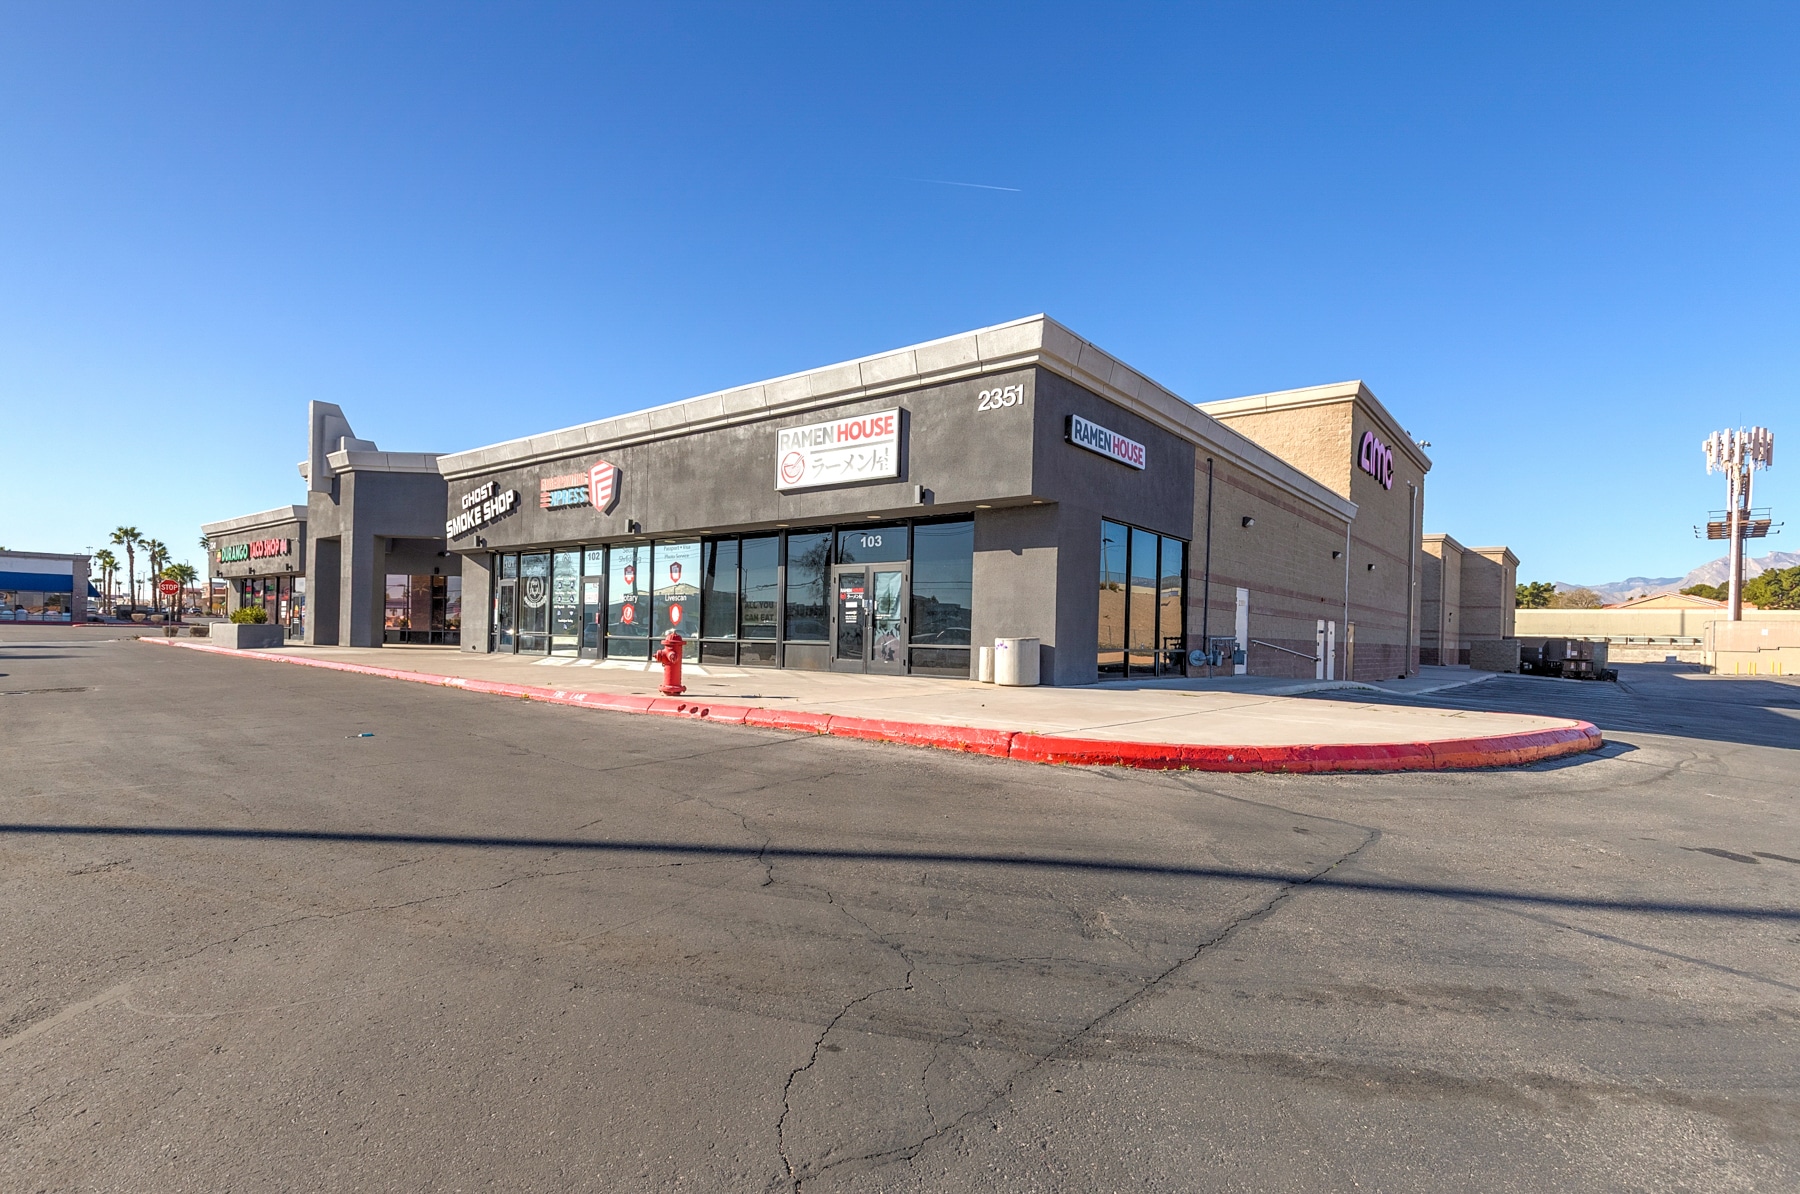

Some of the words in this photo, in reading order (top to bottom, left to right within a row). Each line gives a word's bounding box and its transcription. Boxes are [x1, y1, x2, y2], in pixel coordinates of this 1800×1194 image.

[978, 384, 1024, 411] 2351
[780, 425, 834, 451] RAMEN
[837, 415, 894, 442] HOUSE
[1075, 419, 1111, 452] RAMEN
[1113, 435, 1143, 465] HOUSE
[462, 481, 494, 510] GHOST
[446, 507, 482, 539] SMOKE
[483, 489, 514, 522] SHOP
[221, 544, 248, 562] DURANGO
[249, 541, 263, 558] TACO
[264, 538, 280, 556] SHOP
[860, 535, 882, 548] 103
[587, 552, 600, 561] 102
[665, 594, 687, 602] Livescan
[745, 601, 758, 609] ALL
[759, 601, 774, 609] YOU
[744, 613, 758, 621] CAN
[760, 613, 775, 621] EAT
